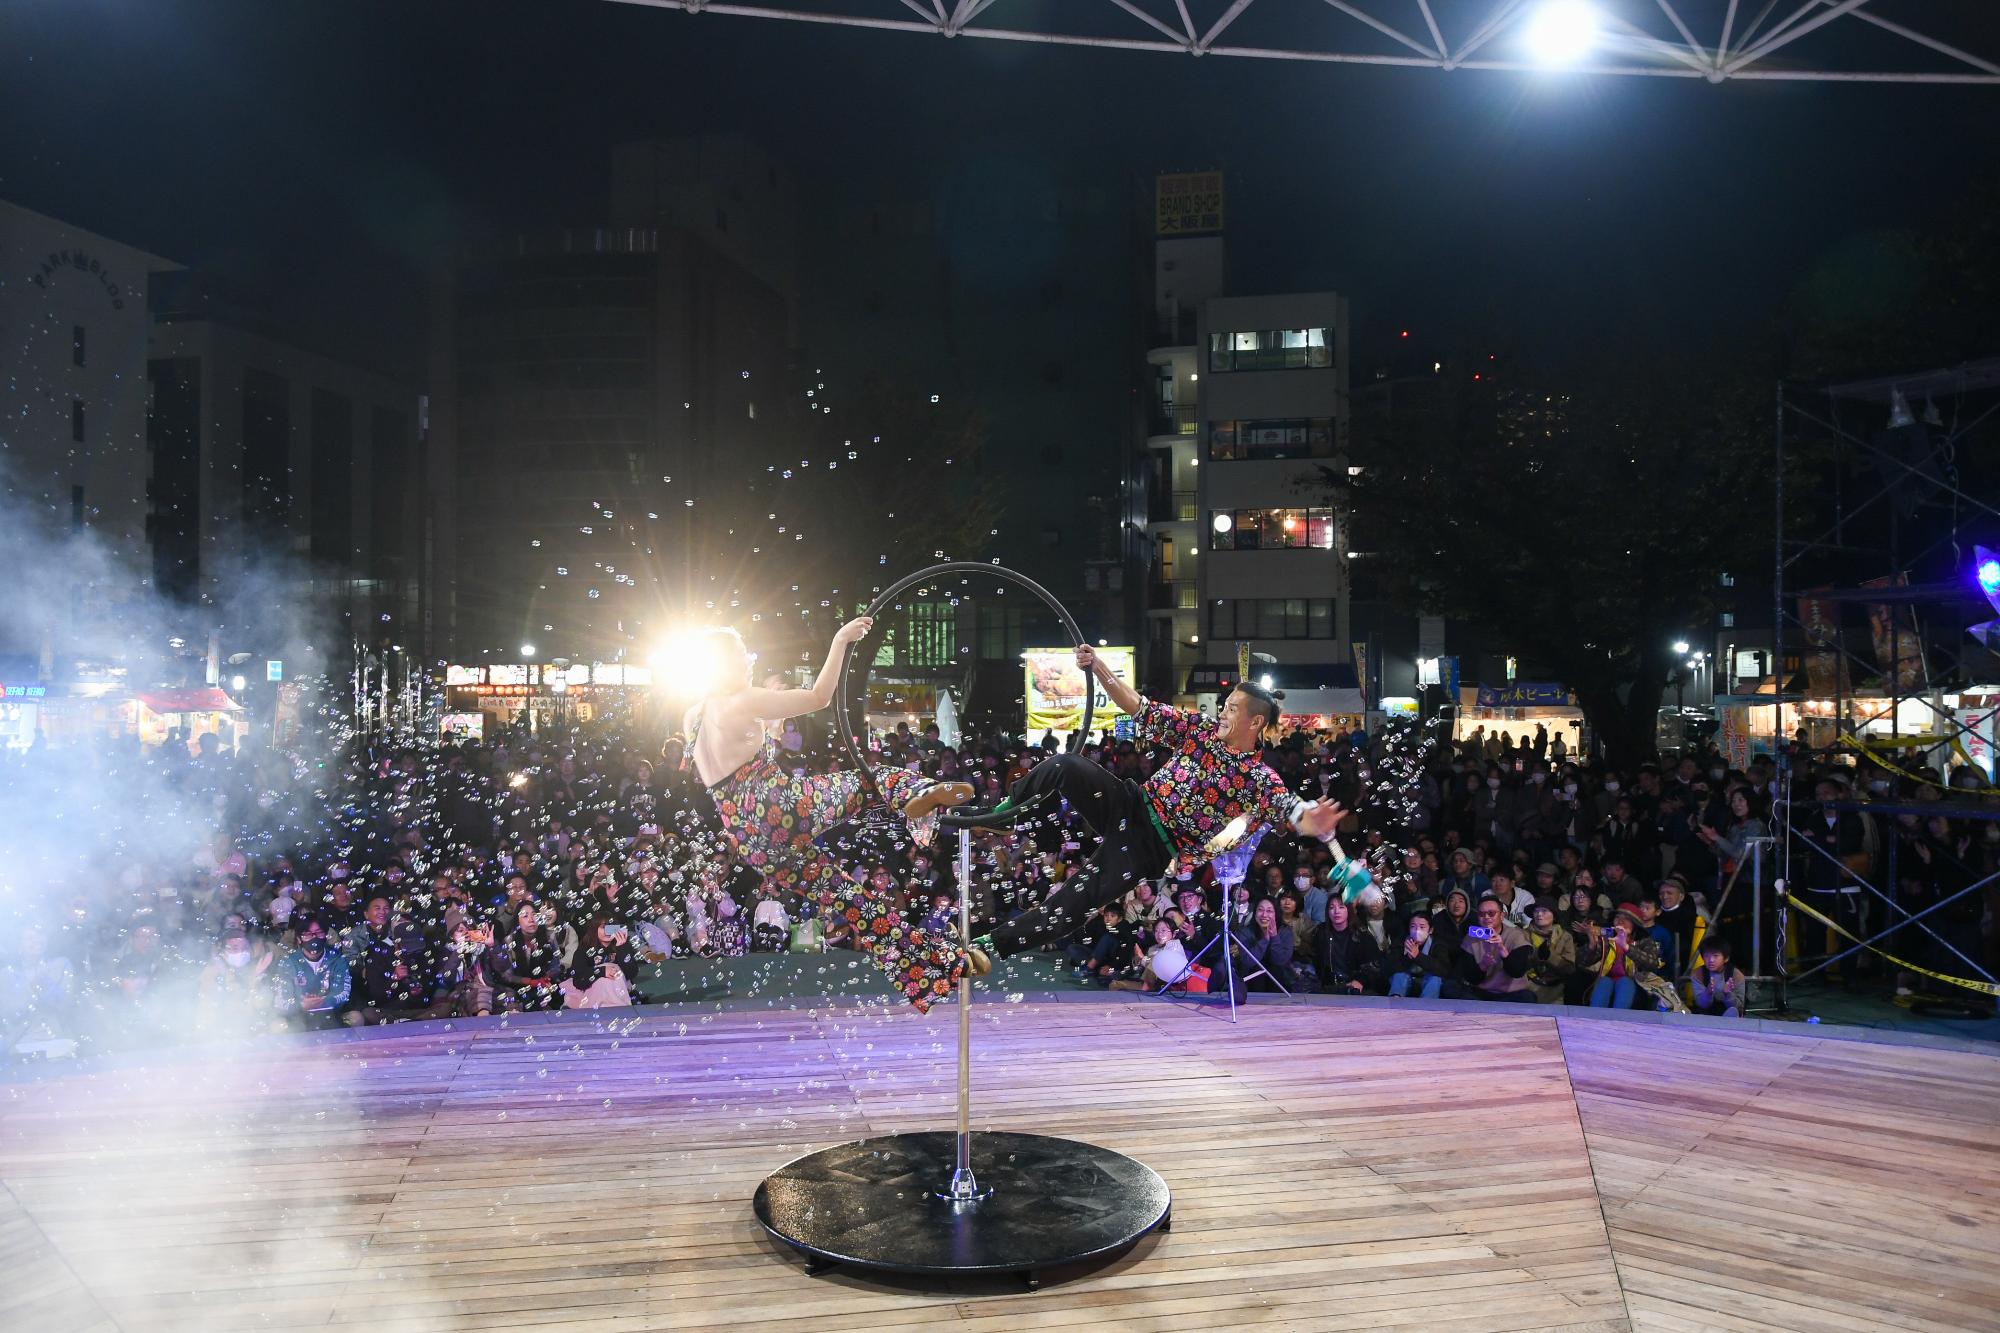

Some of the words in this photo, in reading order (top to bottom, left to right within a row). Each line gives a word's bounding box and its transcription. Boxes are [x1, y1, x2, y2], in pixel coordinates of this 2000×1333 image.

[1160, 195, 1191, 216] BRAND
[1193, 193, 1220, 213] SHOP
[34, 250, 72, 288] PARK
